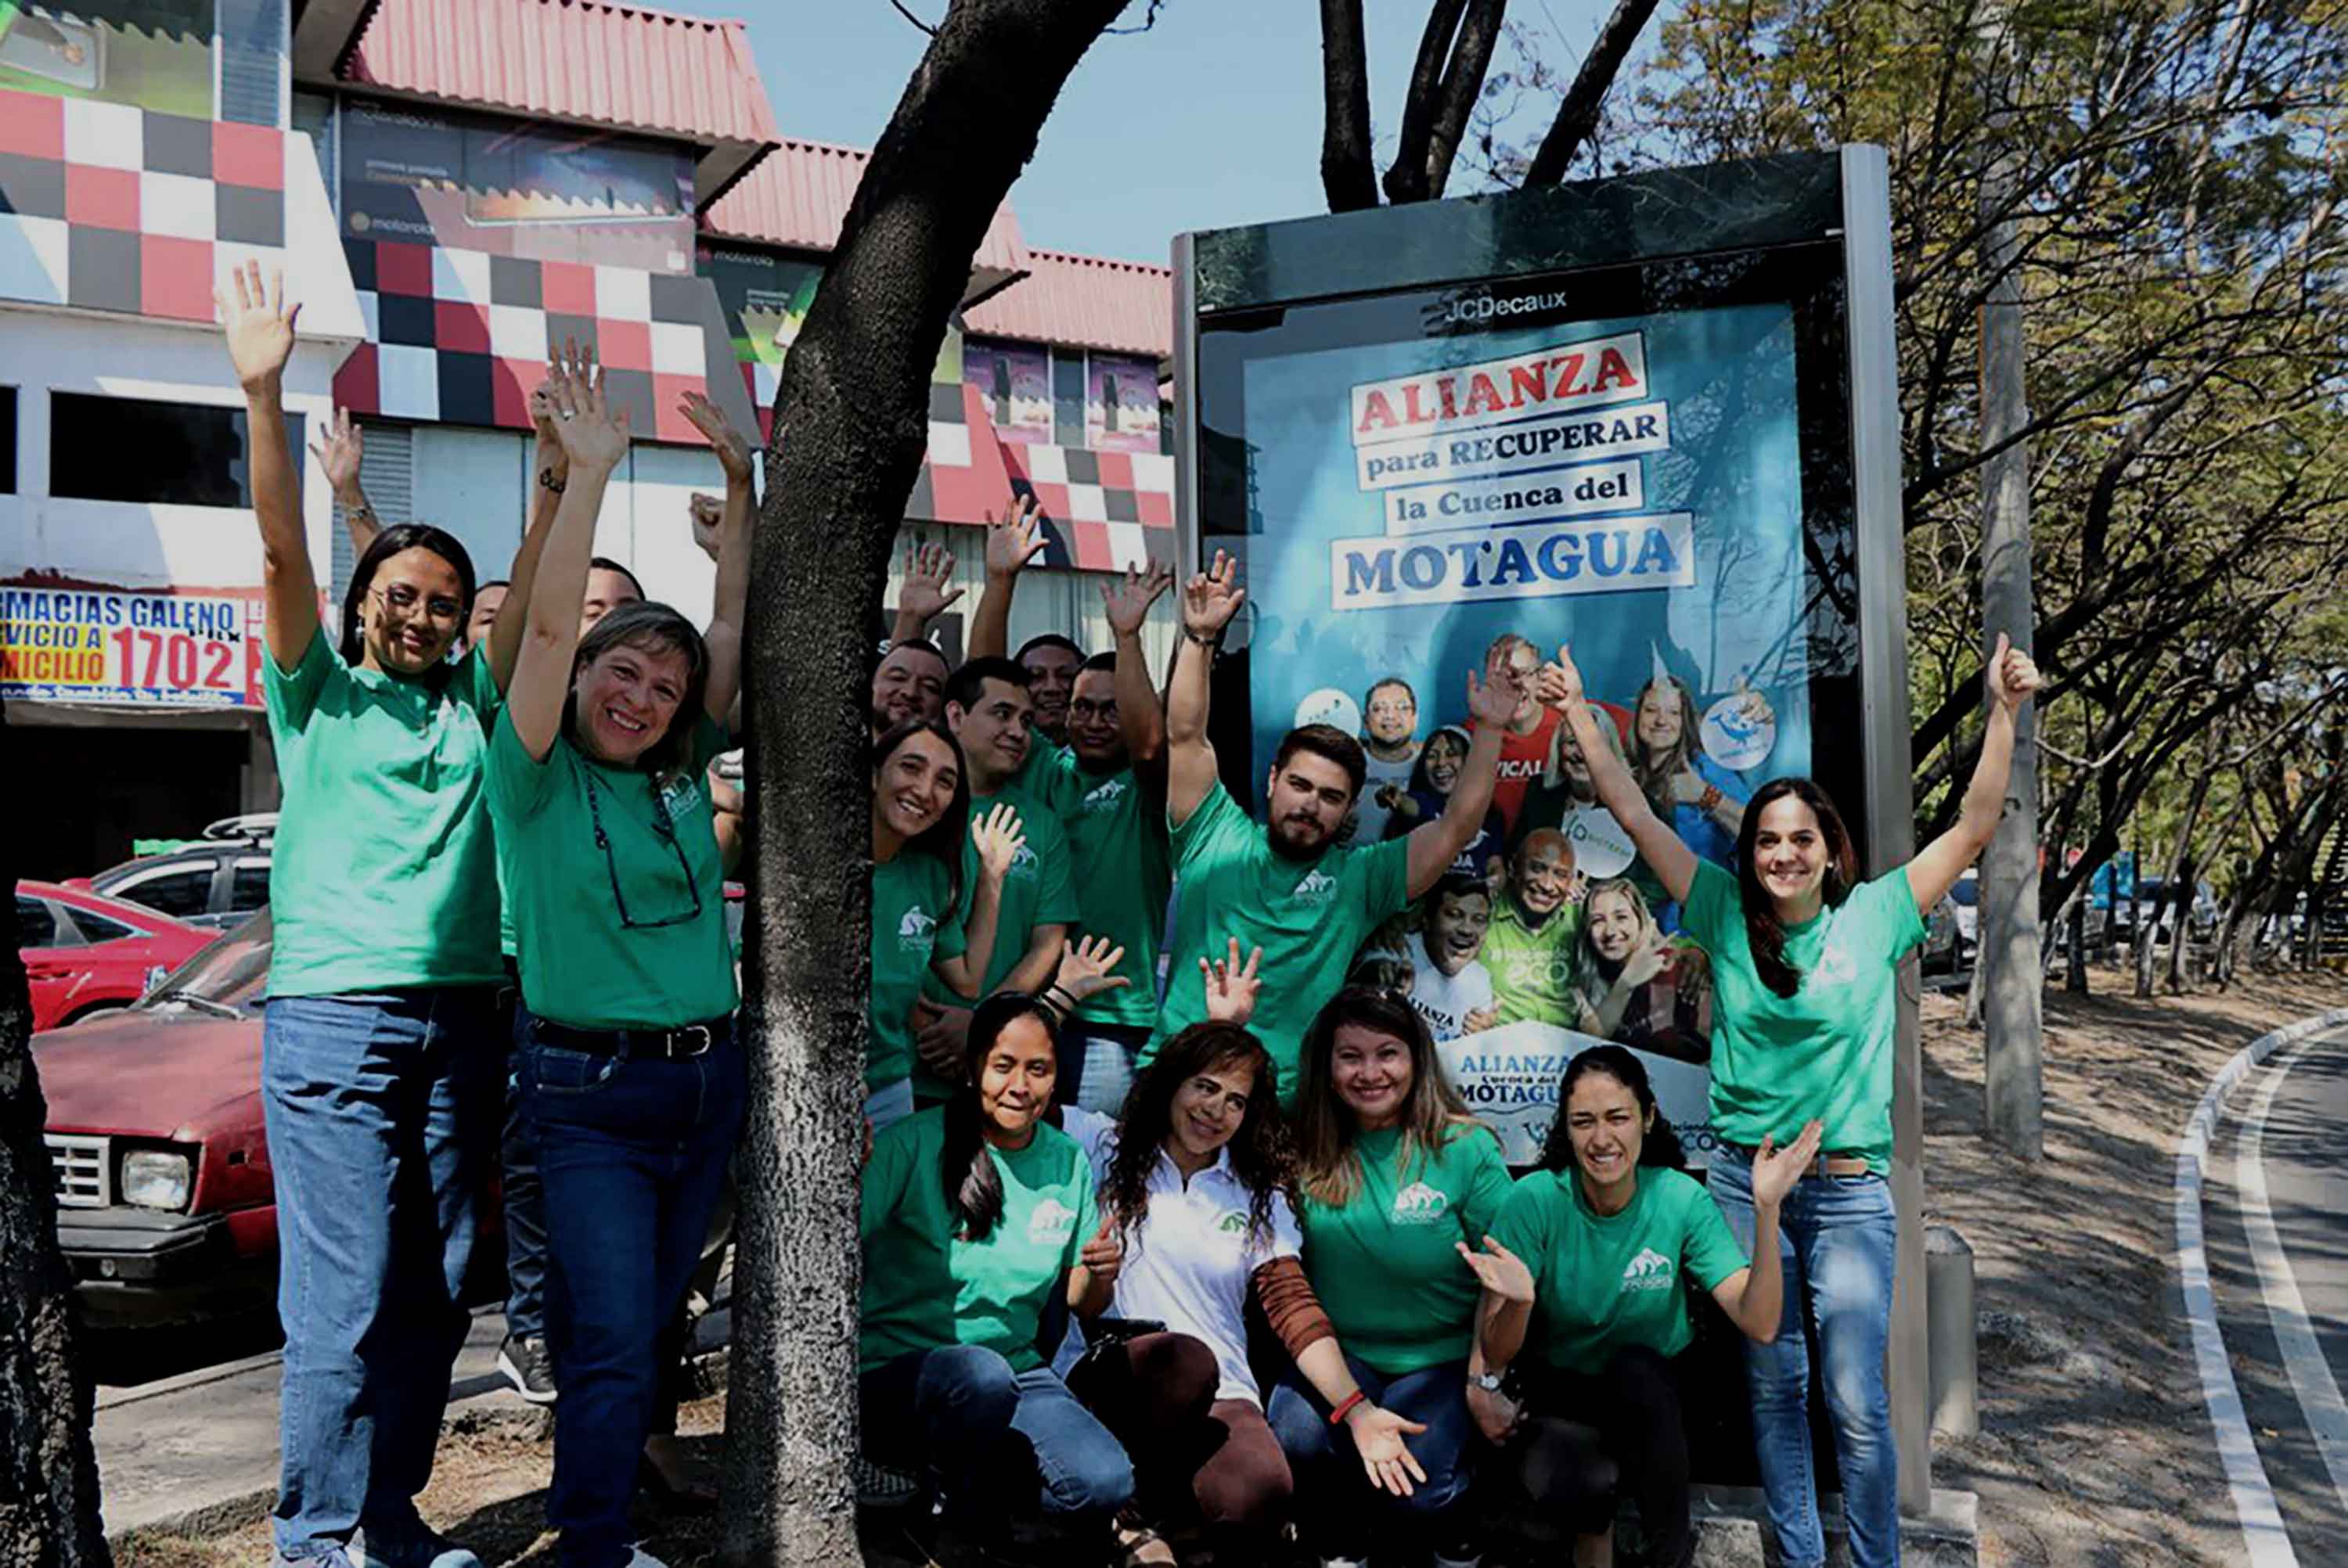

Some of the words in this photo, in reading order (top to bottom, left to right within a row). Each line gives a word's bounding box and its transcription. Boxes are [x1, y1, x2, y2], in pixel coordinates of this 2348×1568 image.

[1445, 290, 1567, 322] JCDecaux
[1357, 346, 1639, 434] ALIANZA
[1366, 444, 1439, 482] para
[1449, 413, 1659, 466] RECUPERAR
[1396, 495, 1428, 522] la
[1439, 486, 1564, 516] Cuenca
[1574, 473, 1630, 502] del
[1343, 526, 1681, 597] MOTAGUA
[0, 591, 122, 626] MACIAS
[131, 597, 235, 631] GALENO
[0, 622, 78, 649] VICIO
[85, 627, 102, 649] A
[112, 626, 234, 691] 1702
[1456, 1084, 1560, 1103] MOTAGU
